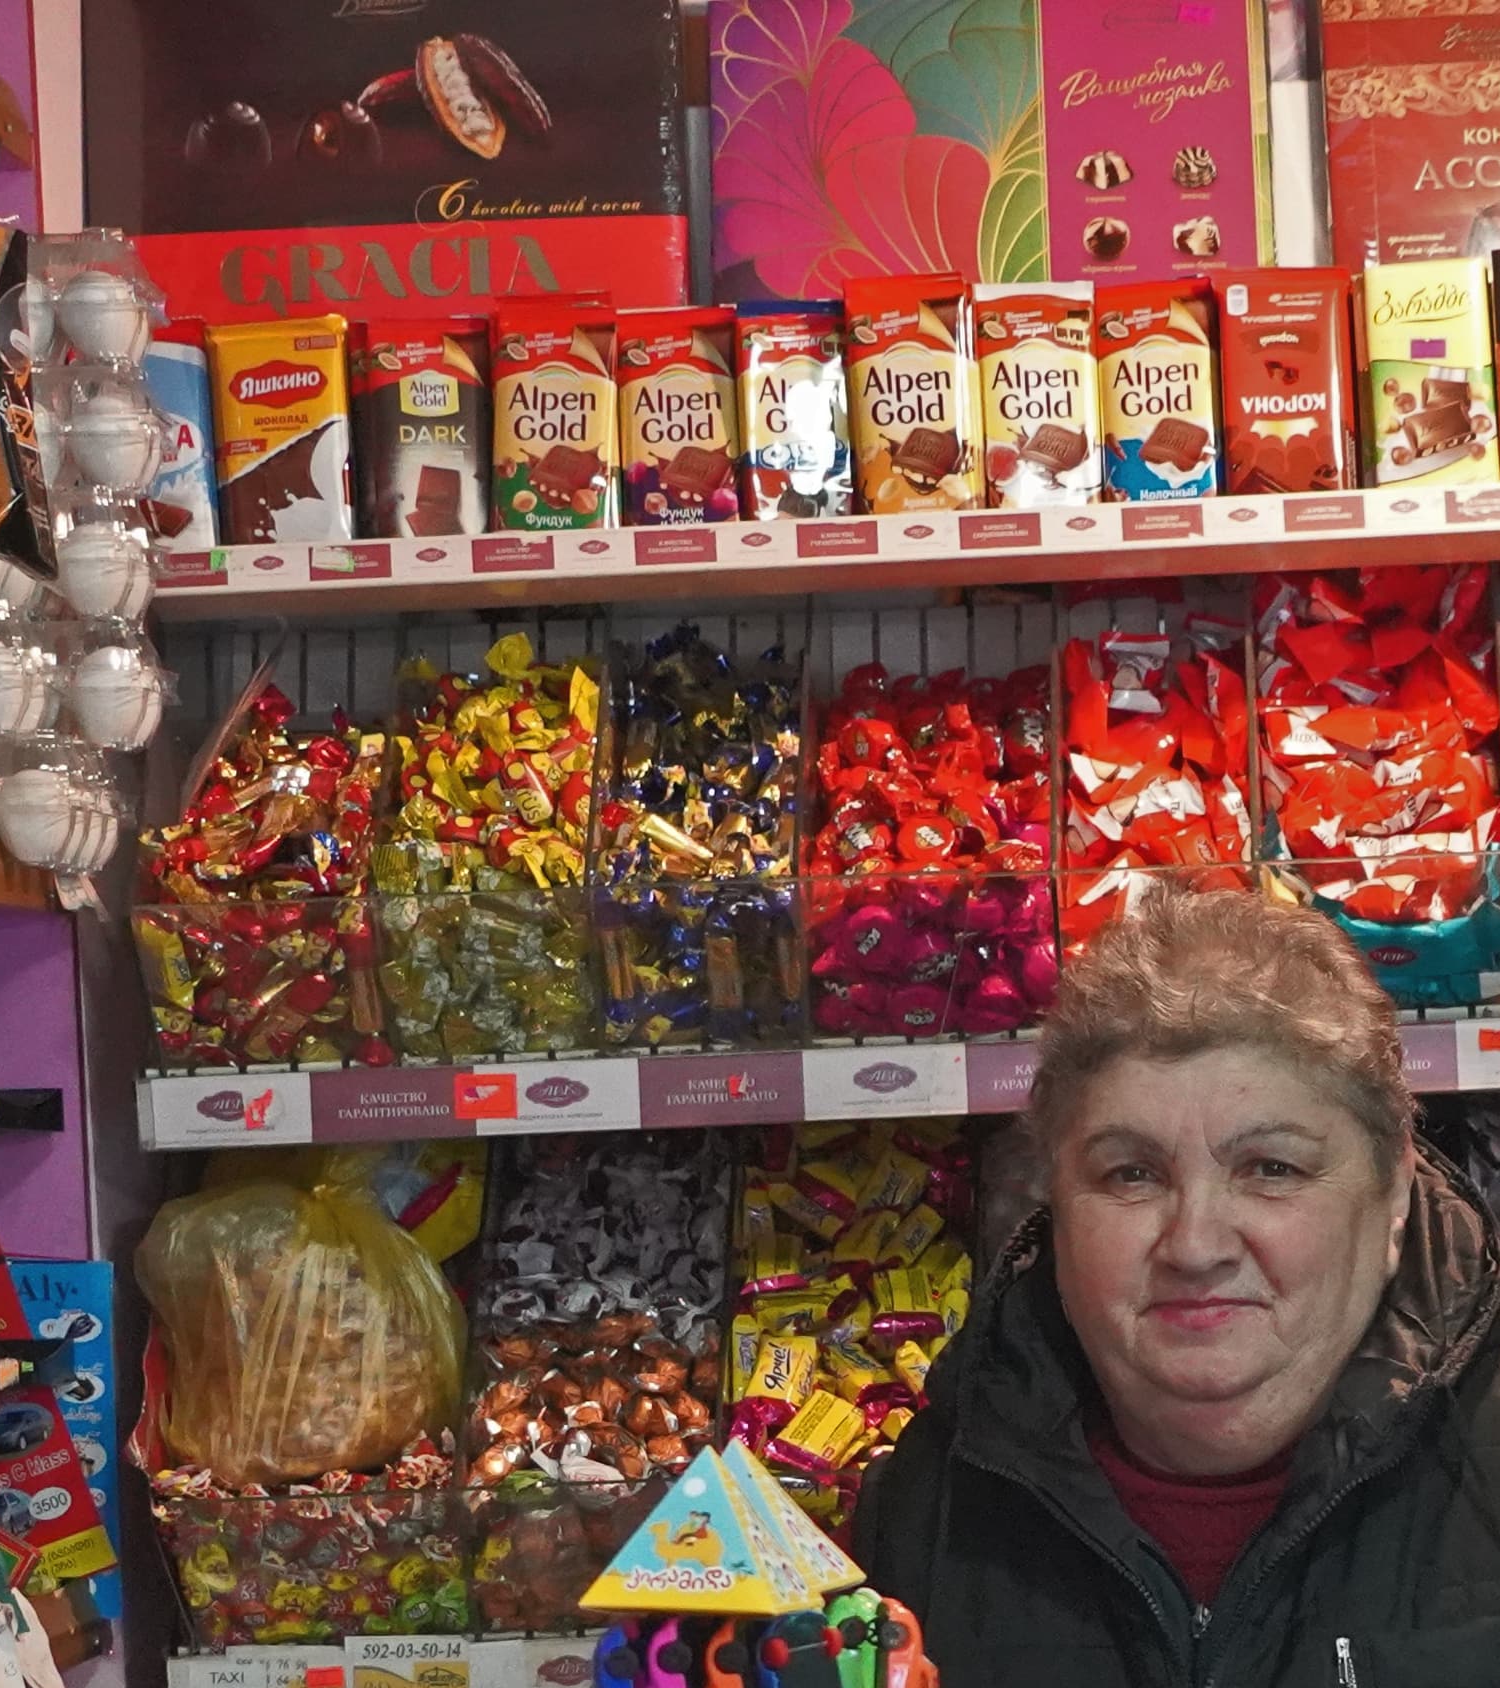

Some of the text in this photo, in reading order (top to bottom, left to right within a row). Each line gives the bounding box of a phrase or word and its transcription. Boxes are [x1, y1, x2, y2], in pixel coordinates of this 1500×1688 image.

[1060, 57, 1206, 109] Волшебная
[1132, 61, 1237, 123] мозаика
[220, 236, 561, 316] GRACIA
[239, 371, 321, 400] Яшкино
[863, 366, 952, 396] Alpen
[991, 361, 1080, 396] Alpen
[1112, 358, 1199, 391] Alpen
[409, 380, 450, 400] Alpen
[412, 390, 447, 408] Gold
[508, 383, 597, 413] Alpen
[634, 384, 722, 415] Alpen
[1120, 384, 1194, 417] Gold
[1240, 392, 1326, 414] КОРОНА
[870, 394, 946, 426] Gold
[999, 393, 1073, 421] Gold
[399, 424, 467, 444] DARK
[513, 411, 587, 442] Gold
[640, 413, 715, 443] Gold
[525, 511, 574, 528] Фундук
[658, 505, 705, 521] Фундук
[667, 1089, 780, 1106] ГАРАНТИВАНО
[688, 1077, 757, 1092] КАЧЕО
[338, 1105, 451, 1121] ГАРАНТИРОВАНО
[360, 1092, 428, 1107] КАЧЕСТВО
[32, 1491, 69, 1516] 3500
[362, 1642, 462, 1661] 592-03-50-14
[209, 1671, 246, 1685] TAXI
